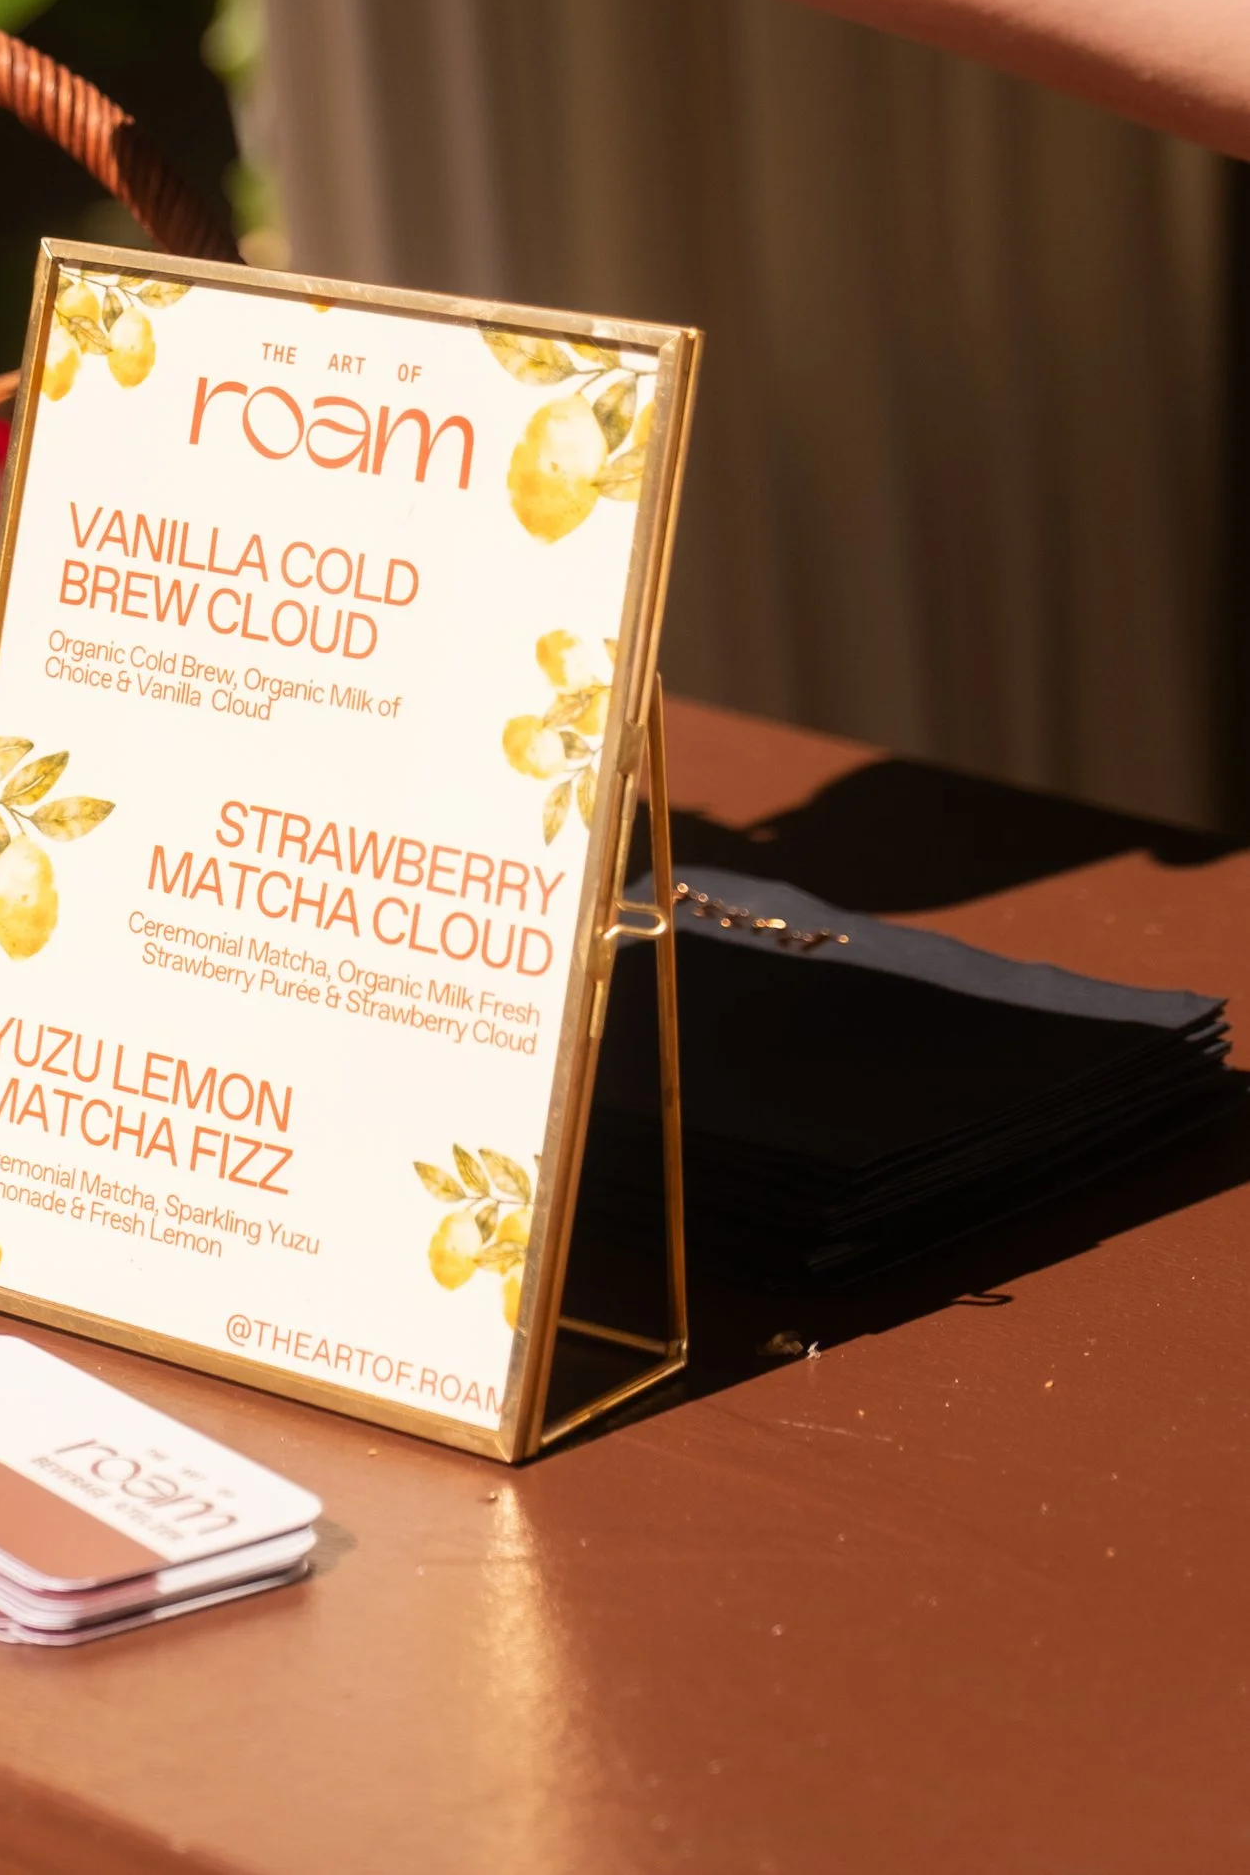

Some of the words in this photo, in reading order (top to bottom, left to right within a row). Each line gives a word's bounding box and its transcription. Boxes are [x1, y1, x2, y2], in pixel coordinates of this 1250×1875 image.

[261, 343, 297, 365] THE
[328, 353, 367, 375] ART
[397, 364, 423, 384] OF
[189, 377, 475, 489] roam
[69, 502, 268, 582] VANILLA
[281, 541, 420, 606] COLD
[59, 559, 200, 627] BREW
[207, 588, 379, 660] CLOUD
[45, 657, 113, 692] Choice
[116, 671, 132, 692] &
[137, 674, 202, 707] Vanilla
[211, 689, 273, 721] Cloud
[49, 631, 126, 667] Organic
[130, 646, 177, 675] Cold
[182, 657, 239, 692] Brew,
[244, 667, 325, 706] Organic
[330, 686, 375, 714] Milk
[378, 696, 403, 720] of
[216, 801, 566, 915] STRAWBERRY
[148, 845, 360, 937] MATCHA
[373, 897, 553, 977] CLOUD
[128, 911, 244, 958] Ceremonial
[248, 938, 331, 982] Matcha,
[338, 960, 423, 999] Organic
[427, 980, 474, 1012] Milk
[480, 992, 541, 1027] Fresh
[142, 942, 255, 993] Strawberry
[260, 971, 320, 1004] Purée
[325, 986, 341, 1008] &
[347, 993, 468, 1043] Strawberry
[473, 1021, 537, 1055] Cloud
[112, 1044, 292, 1132] LEMON
[189, 1125, 294, 1195] FIZZ
[70, 1197, 86, 1219] &
[89, 1200, 146, 1236] Fresh
[150, 1219, 222, 1258] Lemon
[80, 1171, 160, 1216] Matcha,
[165, 1195, 262, 1245] Sparkling
[267, 1220, 321, 1255] Yuzu
[54, 1438, 238, 1535] roam
